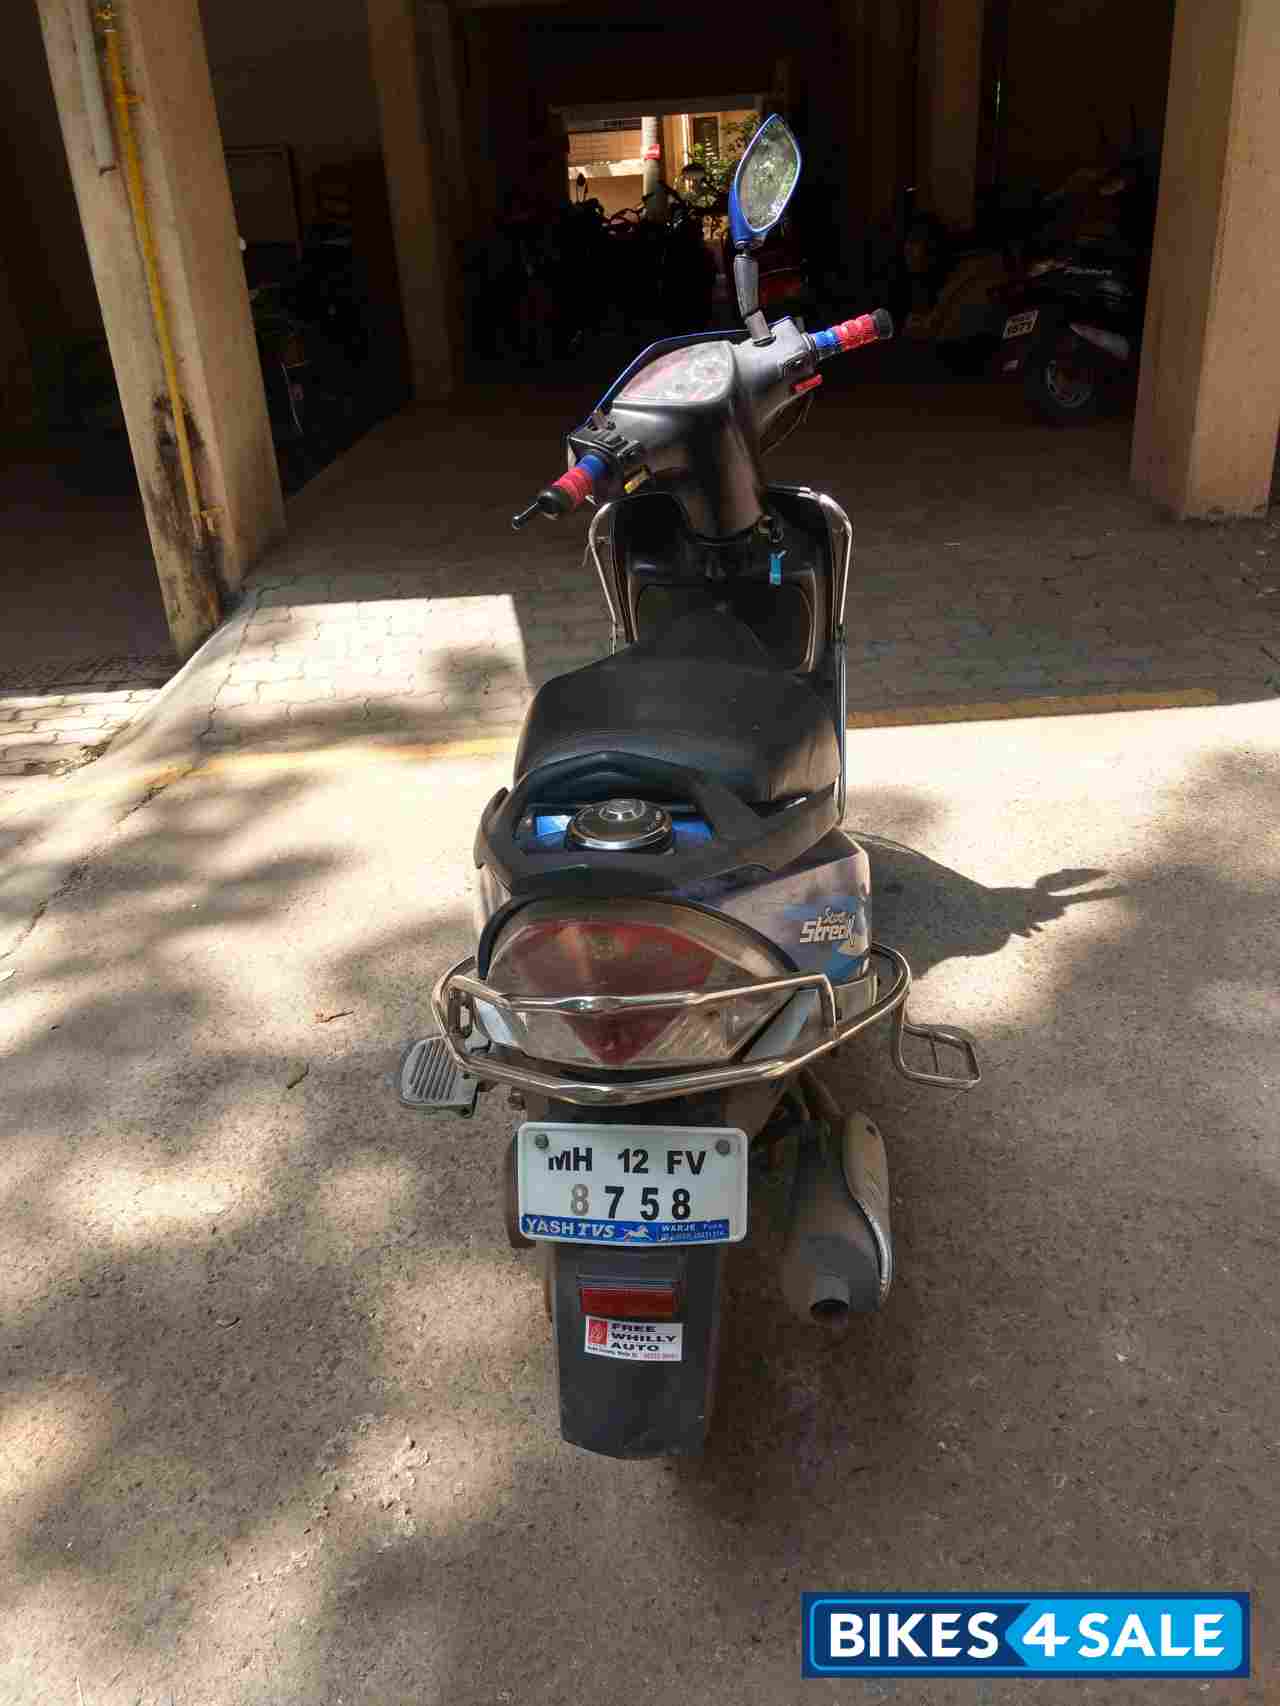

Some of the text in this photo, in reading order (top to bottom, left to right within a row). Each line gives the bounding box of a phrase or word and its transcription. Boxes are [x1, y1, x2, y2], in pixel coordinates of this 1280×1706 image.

[548, 1147, 706, 1175] MH 12 FV
[611, 1322, 657, 1332] FREE
[611, 1331, 677, 1343] WHILLY
[611, 1342, 659, 1351] AUTO
